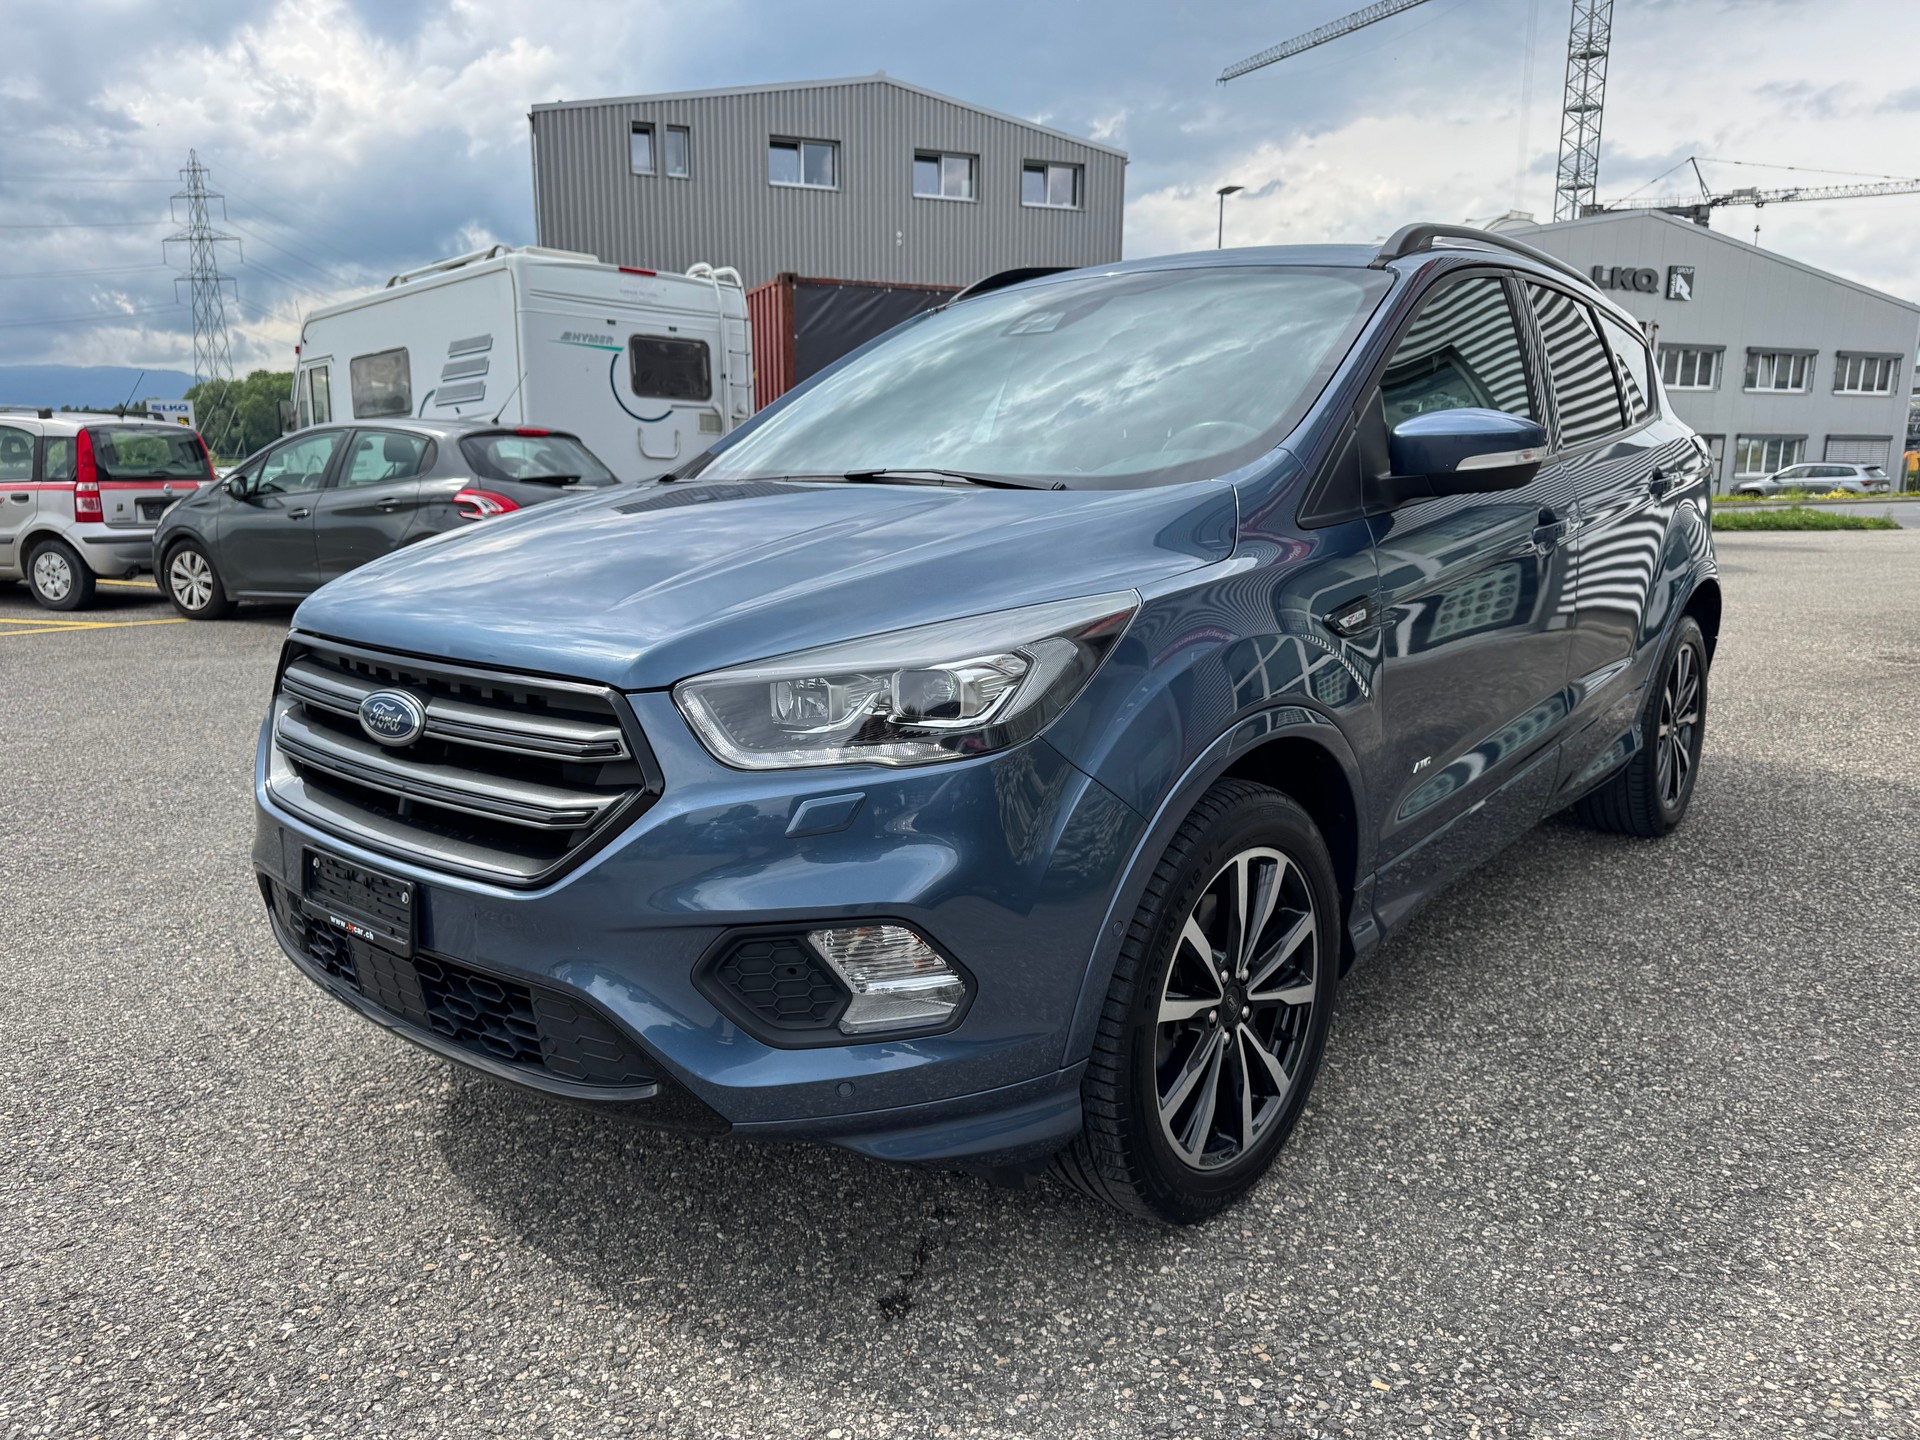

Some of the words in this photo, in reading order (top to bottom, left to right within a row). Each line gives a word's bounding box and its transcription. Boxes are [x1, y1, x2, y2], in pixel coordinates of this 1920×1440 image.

[1593, 265, 1659, 294] LKQ
[369, 702, 403, 732] Ford
[330, 915, 374, 940] www.bycar.ch
